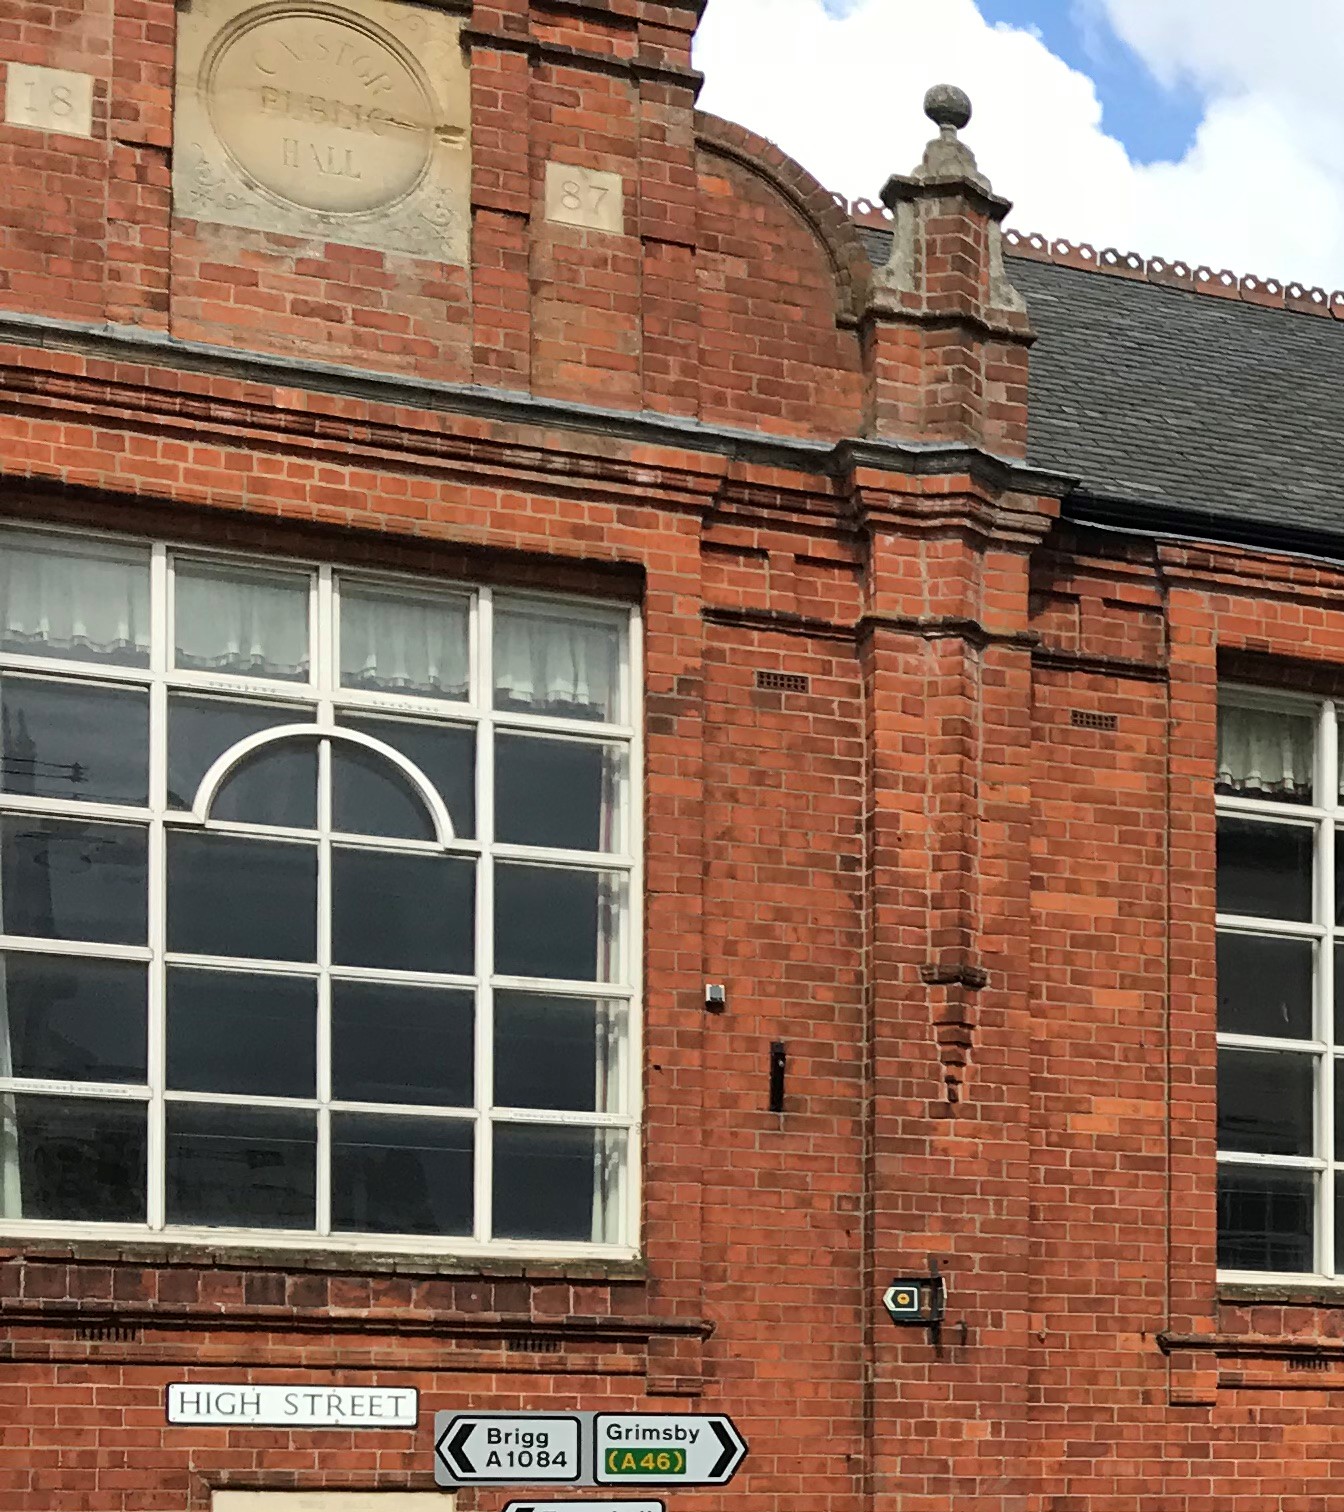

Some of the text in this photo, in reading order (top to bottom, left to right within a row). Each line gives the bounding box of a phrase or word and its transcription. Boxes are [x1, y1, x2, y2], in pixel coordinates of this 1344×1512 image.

[24, 82, 74, 117] 18
[282, 137, 362, 181] HALL
[561, 180, 609, 215] 87
[179, 1391, 407, 1417] HIGH STREET
[487, 1428, 549, 1448] Brigg
[606, 1423, 700, 1444] Grimsby
[486, 1451, 568, 1468] A1084
